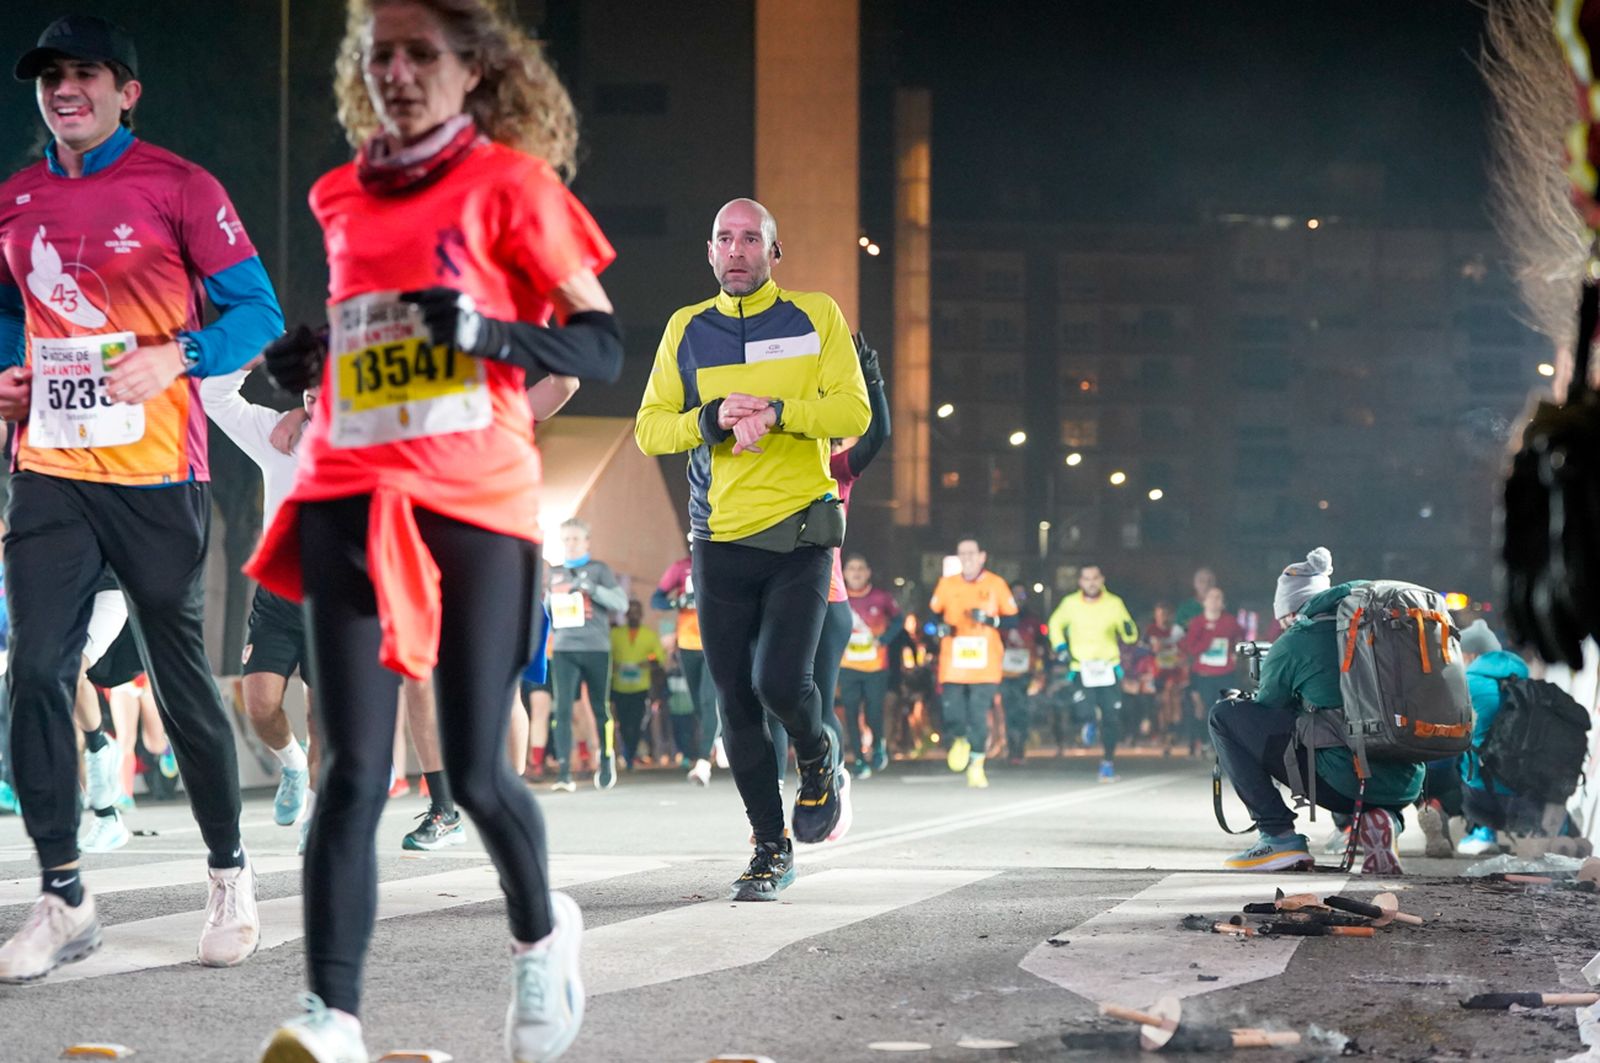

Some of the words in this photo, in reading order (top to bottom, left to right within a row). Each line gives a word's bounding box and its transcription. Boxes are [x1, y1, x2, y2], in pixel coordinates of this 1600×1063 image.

[50, 283, 78, 313] 43
[76, 350, 89, 362] DE
[1248, 845, 1273, 858] HOKA
